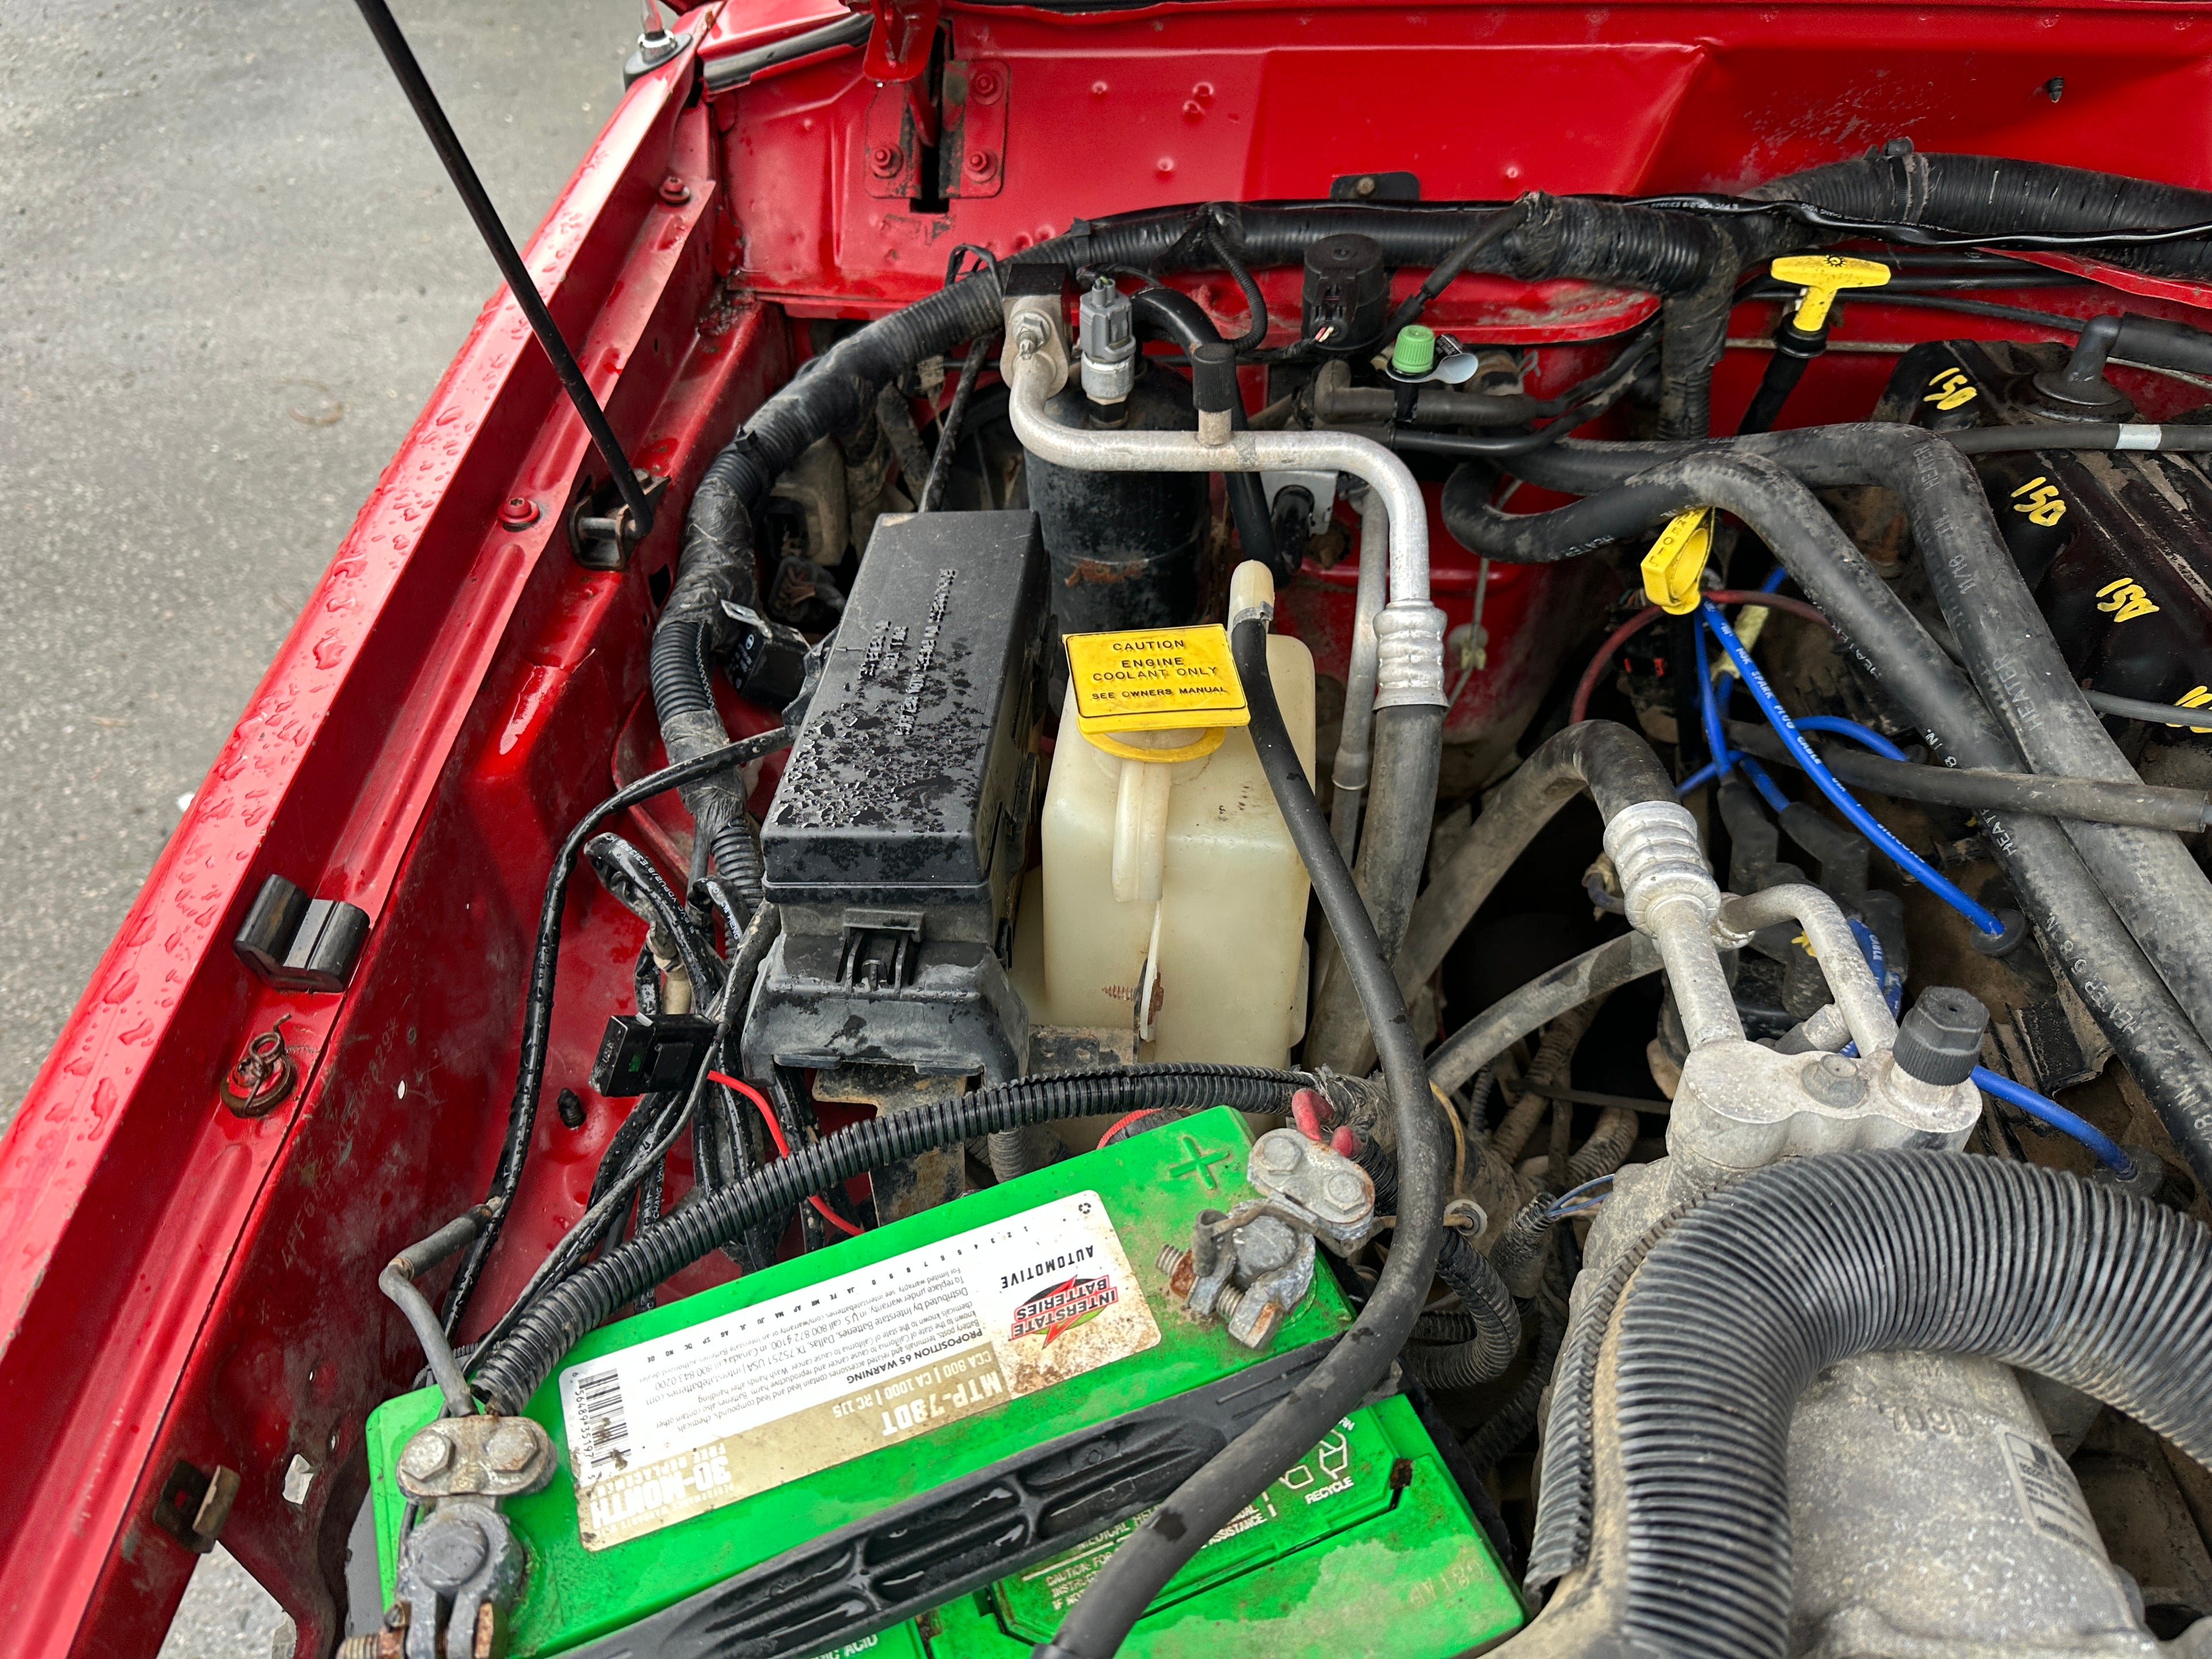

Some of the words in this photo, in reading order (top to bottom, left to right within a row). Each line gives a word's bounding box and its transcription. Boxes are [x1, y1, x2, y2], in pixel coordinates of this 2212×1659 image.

[1923, 368, 1977, 410] 150
[2011, 476, 2066, 527] 150
[2096, 577, 2159, 623] 150
[1113, 640, 1184, 651] CAUTION
[1122, 657, 1184, 668] ENGINE
[1093, 669, 1167, 681] COOLANT
[1177, 666, 1217, 676] ONLY
[1122, 688, 1172, 697] OWNERS
[1179, 687, 1227, 695] MANUAL
[1751, 671, 1774, 699] SPARK
[1993, 654, 2043, 731] HEATER
[653, 1187, 663, 1220] CHANG
[950, 1267, 960, 1275] For
[998, 1245, 1097, 1289] AUTOMOTIVE
[926, 1270, 949, 1283] limited
[954, 1275, 964, 1285] To
[884, 1289, 895, 1297] see
[926, 1277, 955, 1294] replace
[903, 1287, 927, 1303] under
[923, 1286, 968, 1309] Distributed
[1013, 1278, 1110, 1321] BATTERIES
[868, 1295, 903, 1315] warranty,
[911, 1300, 923, 1313] by
[940, 1301, 973, 1318] chemicals
[859, 1310, 867, 1319] in
[873, 1306, 912, 1327] Interstate
[918, 1312, 941, 1326] known
[945, 1317, 953, 1326] to
[953, 1309, 976, 1324] known
[1011, 1290, 1118, 1337] INTERSTATE
[828, 1318, 842, 1331] call
[835, 1320, 873, 1341] Batteries,
[898, 1323, 910, 1334] the
[910, 1320, 918, 1328] to
[917, 1324, 934, 1336] state
[934, 1320, 946, 1331] the
[955, 1317, 979, 1334] Battery
[874, 1334, 881, 1342] of
[881, 1327, 898, 1339] state
[910, 1331, 918, 1340] of
[935, 1325, 956, 1340] posts,
[729, 1336, 760, 1353] Interstate
[759, 1344, 767, 1354] in
[796, 1344, 806, 1355] TX
[806, 1333, 835, 1351] Dallas,
[841, 1336, 873, 1354] California
[869, 1345, 877, 1354] to
[877, 1334, 910, 1351] California
[904, 1334, 936, 1352] terminals
[913, 1328, 983, 1359] PROPOSITION
[699, 1348, 728, 1363] Batteries
[728, 1347, 758, 1365] Canada
[767, 1347, 794, 1365] 75251
[813, 1351, 832, 1363] cause
[834, 1348, 841, 1357] to
[850, 1348, 869, 1360] cause
[866, 1350, 890, 1366] related
[890, 1345, 904, 1357] and
[898, 1353, 912, 1365] 65
[966, 1349, 993, 1369] CCA
[661, 1358, 697, 1377] authorized
[746, 1358, 765, 1372] USA
[813, 1363, 827, 1374] and
[827, 1355, 849, 1368] cancer
[828, 1359, 865, 1378] accessories
[941, 1358, 967, 1378] 800
[769, 1366, 788, 1379] Wash
[769, 1366, 812, 1389] reproductive
[845, 1358, 897, 1384] WARNING
[730, 1382, 745, 1393] after
[747, 1374, 768, 1388] hands
[802, 1373, 828, 1388] contain
[914, 1371, 933, 1388] CA
[771, 1388, 786, 1400] and
[786, 1382, 802, 1395] lead
[882, 1378, 915, 1400] 1000
[574, 1388, 588, 1422] 56489
[717, 1391, 747, 1408] Batteries
[756, 1393, 771, 1406] lead
[855, 1393, 874, 1411] RC
[877, 1369, 1003, 1437] MTP-78DT
[675, 1407, 701, 1423] contain
[702, 1402, 717, 1414] also
[712, 1397, 755, 1421] compounds,
[831, 1399, 855, 1419] 115
[656, 1417, 674, 1430] other
[676, 1414, 711, 1434] chemicals
[580, 1425, 593, 1460] 35197
[691, 1441, 726, 1464] FREE
[589, 1453, 732, 1531] 30-MONTH
[1305, 1476, 1354, 1505] RECYCLE
